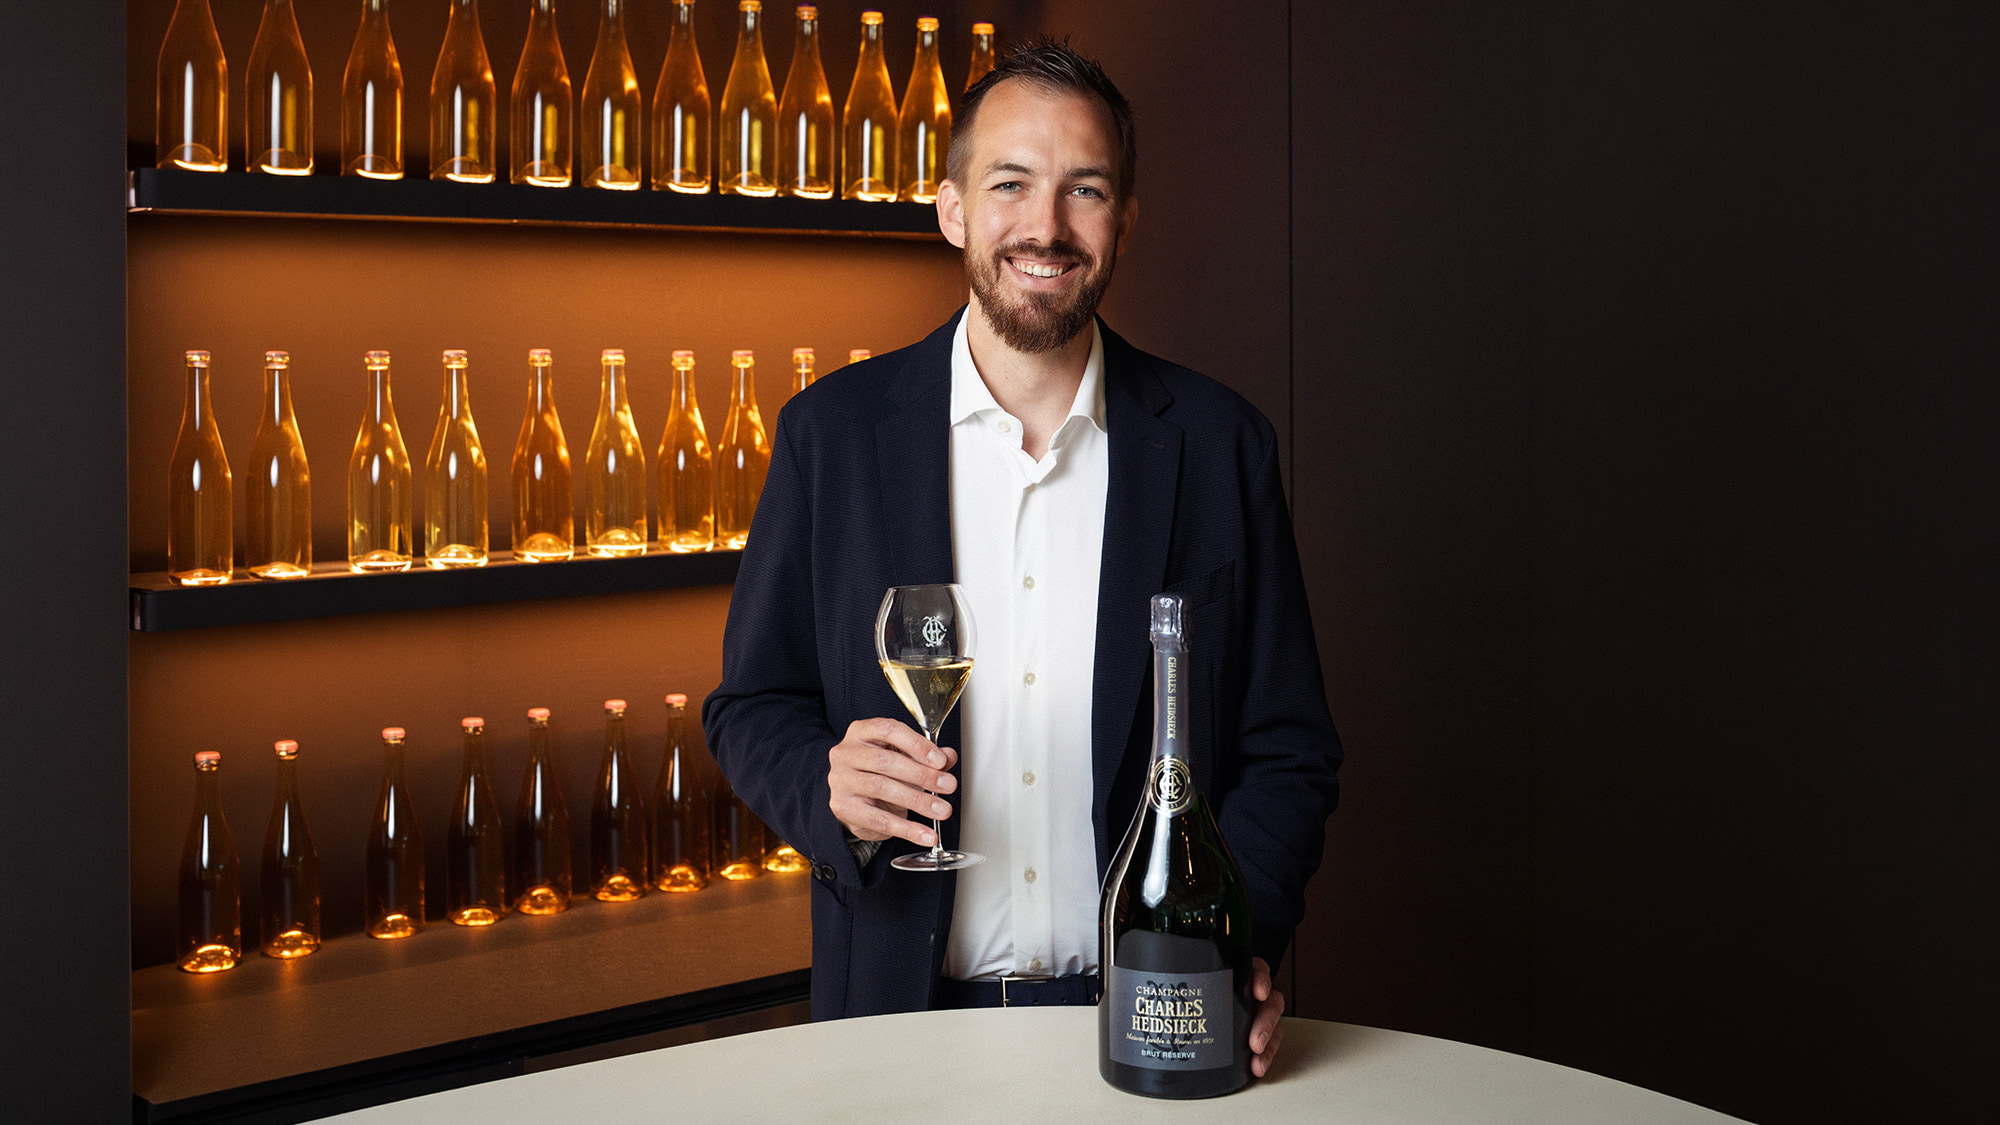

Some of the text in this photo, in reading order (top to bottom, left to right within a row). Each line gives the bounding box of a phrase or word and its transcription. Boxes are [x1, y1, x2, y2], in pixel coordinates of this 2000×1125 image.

[1167, 656, 1177, 740] CHARLES HEIDSIECK
[1136, 985, 1203, 996] CHAMPAGNE
[1135, 996, 1203, 1017] CHARLES
[1131, 1015, 1207, 1034] HEIDSIECK
[1126, 1032, 1144, 1042] Maison
[1141, 1049, 1160, 1057] BRUT
